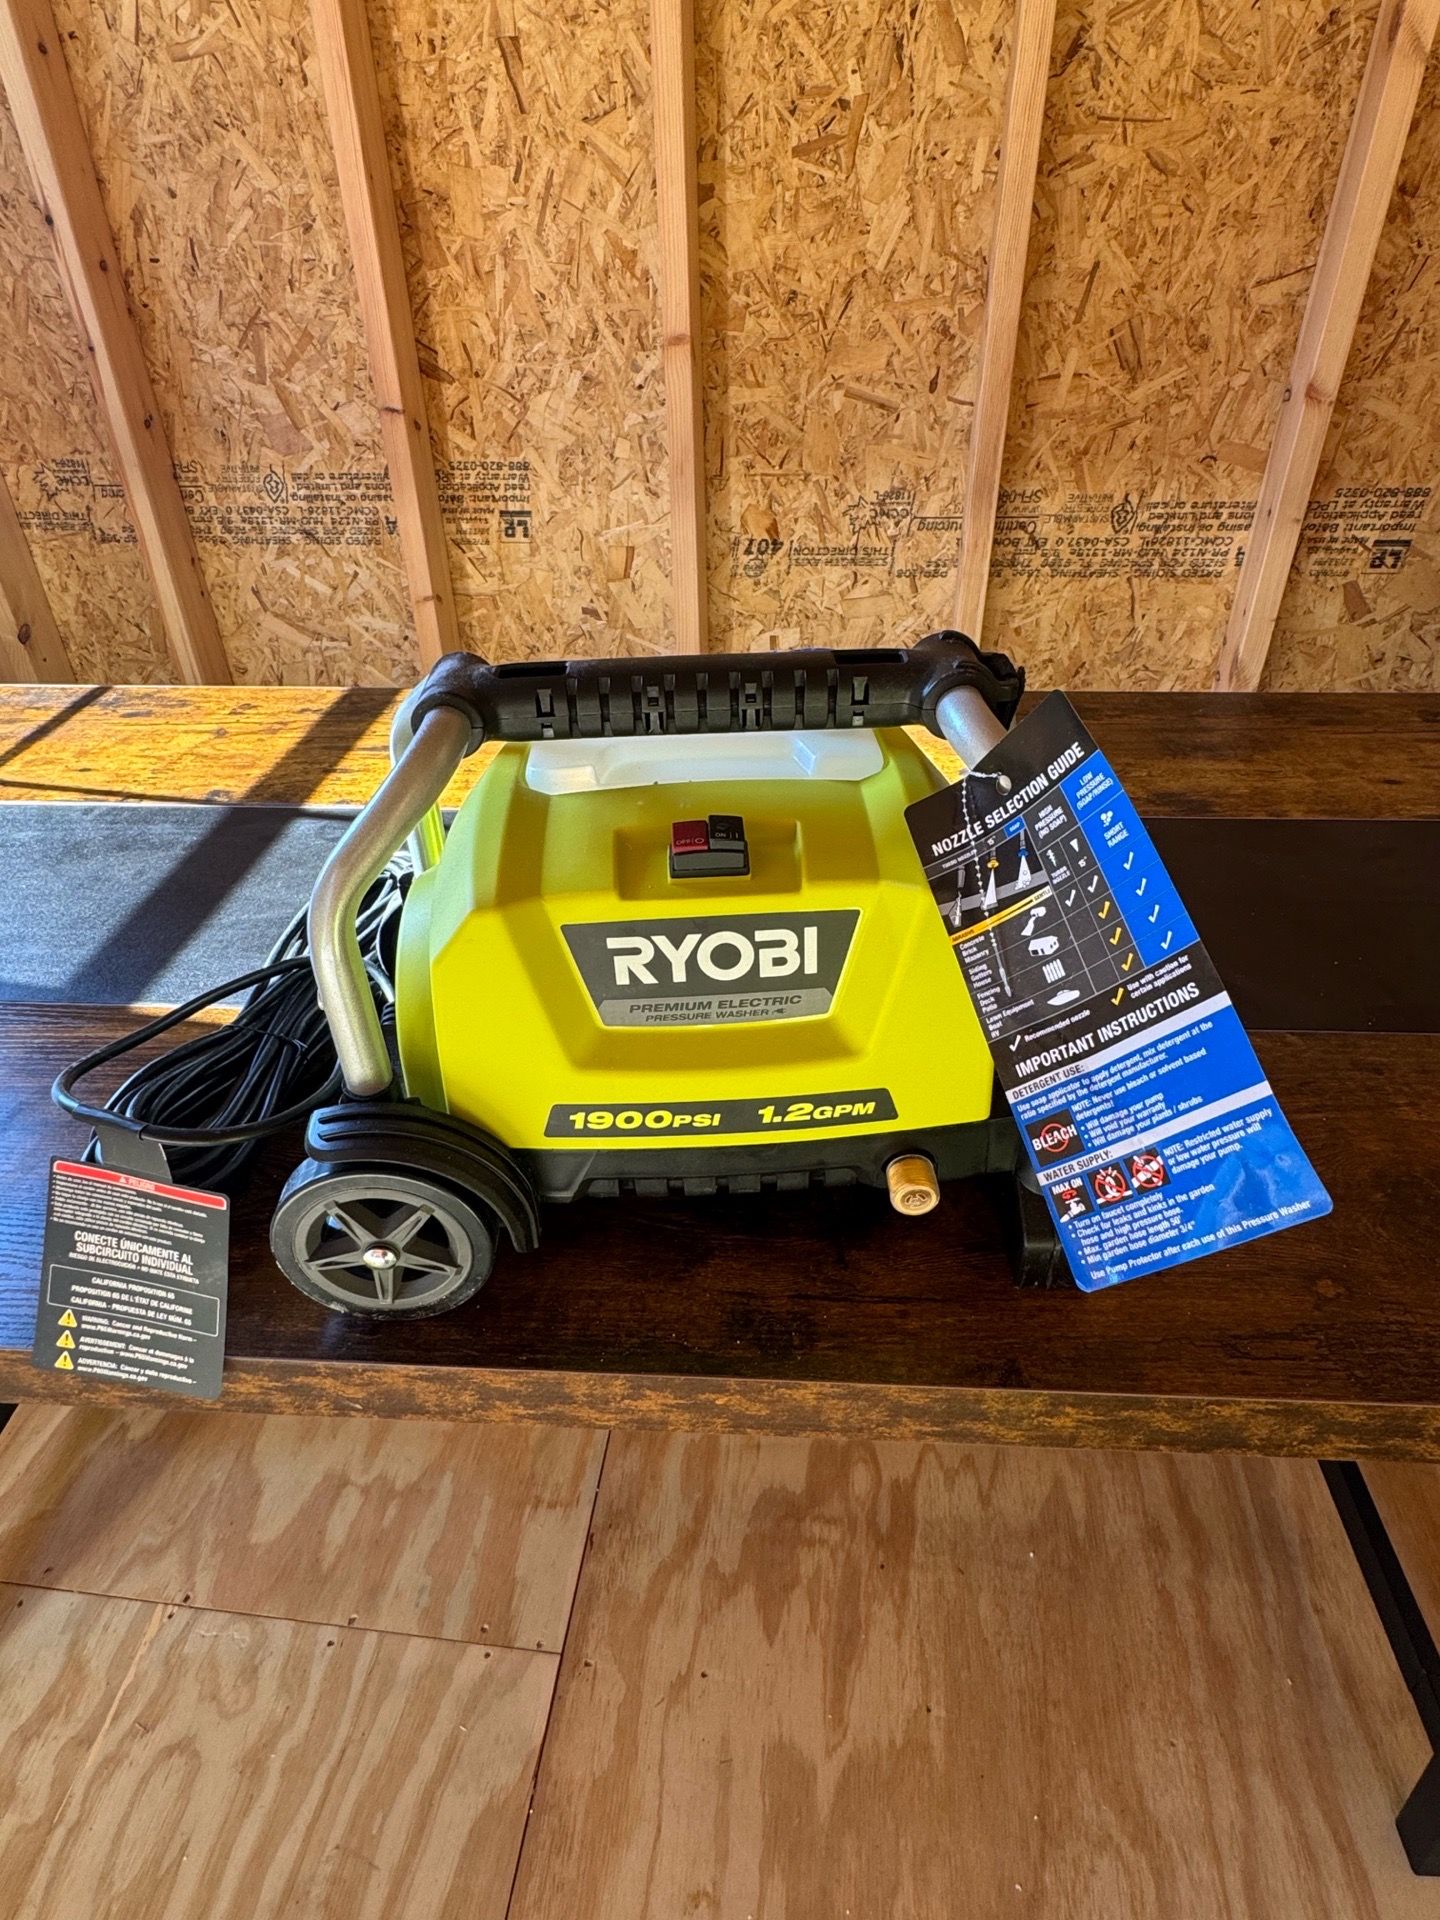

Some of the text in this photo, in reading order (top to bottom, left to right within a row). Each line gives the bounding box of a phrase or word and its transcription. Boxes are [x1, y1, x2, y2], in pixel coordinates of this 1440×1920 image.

[1076, 772, 1106, 799] PRESSURE
[1080, 772, 1093, 786] LOW
[931, 740, 1084, 856] NOZZLE SELECTION GUIDE
[1034, 806, 1063, 831] PRESSURE
[1103, 821, 1124, 840] SHORT
[1106, 828, 1129, 848] RANGE
[606, 926, 818, 986] RYOBI
[1129, 961, 1192, 998] certain applications
[629, 994, 802, 1014] PREMIUM ELECTRIC
[646, 1008, 769, 1023] PRESSURE WASHER
[1014, 981, 1201, 1078] IMPORTANT INSTRUCTIONS
[1023, 1017, 1070, 1043] Recommended
[1046, 1080, 1082, 1102] applicator
[1089, 1068, 1110, 1084] apply
[1155, 1030, 1192, 1053] detergent
[1199, 1020, 1213, 1031] the
[1091, 1046, 1207, 1104] Never bleach solvent based
[1011, 1062, 1084, 1099] DETERGENT USE:
[1035, 1096, 1067, 1115] specified
[1088, 1072, 1122, 1092] detergent
[569, 1110, 721, 1130] 1900PSI
[758, 1101, 876, 1124] 1.2GPM
[1099, 1092, 1164, 1126] damage pump
[1106, 1094, 1203, 1142] damage plants shrubs
[1135, 1100, 1167, 1120] warranty
[1031, 1123, 1077, 1151] BLEACH
[1162, 1107, 1273, 1157] NOTE: Restricted water supply
[1189, 1128, 1246, 1156] water pressure
[1043, 1148, 1113, 1183] WATER SUPPLY:
[1170, 1141, 1244, 1175] damage pump.
[1051, 1176, 1082, 1195] MAX ON
[1073, 1191, 1164, 1230] Turn faucet completely
[1076, 1183, 1216, 1238] Check for leaks and kinks the garden
[74, 1229, 118, 1249] CONECTE
[1080, 1212, 1163, 1247] hose and high pressure
[1090, 1199, 1312, 1280] Use Pump Protector after each use this Pressure Washer
[1102, 1219, 1171, 1250] garden hose length
[1102, 1226, 1178, 1260] garden hose diameter
[76, 1240, 193, 1275] SUBCIRCUITO INDIVIDUAL
